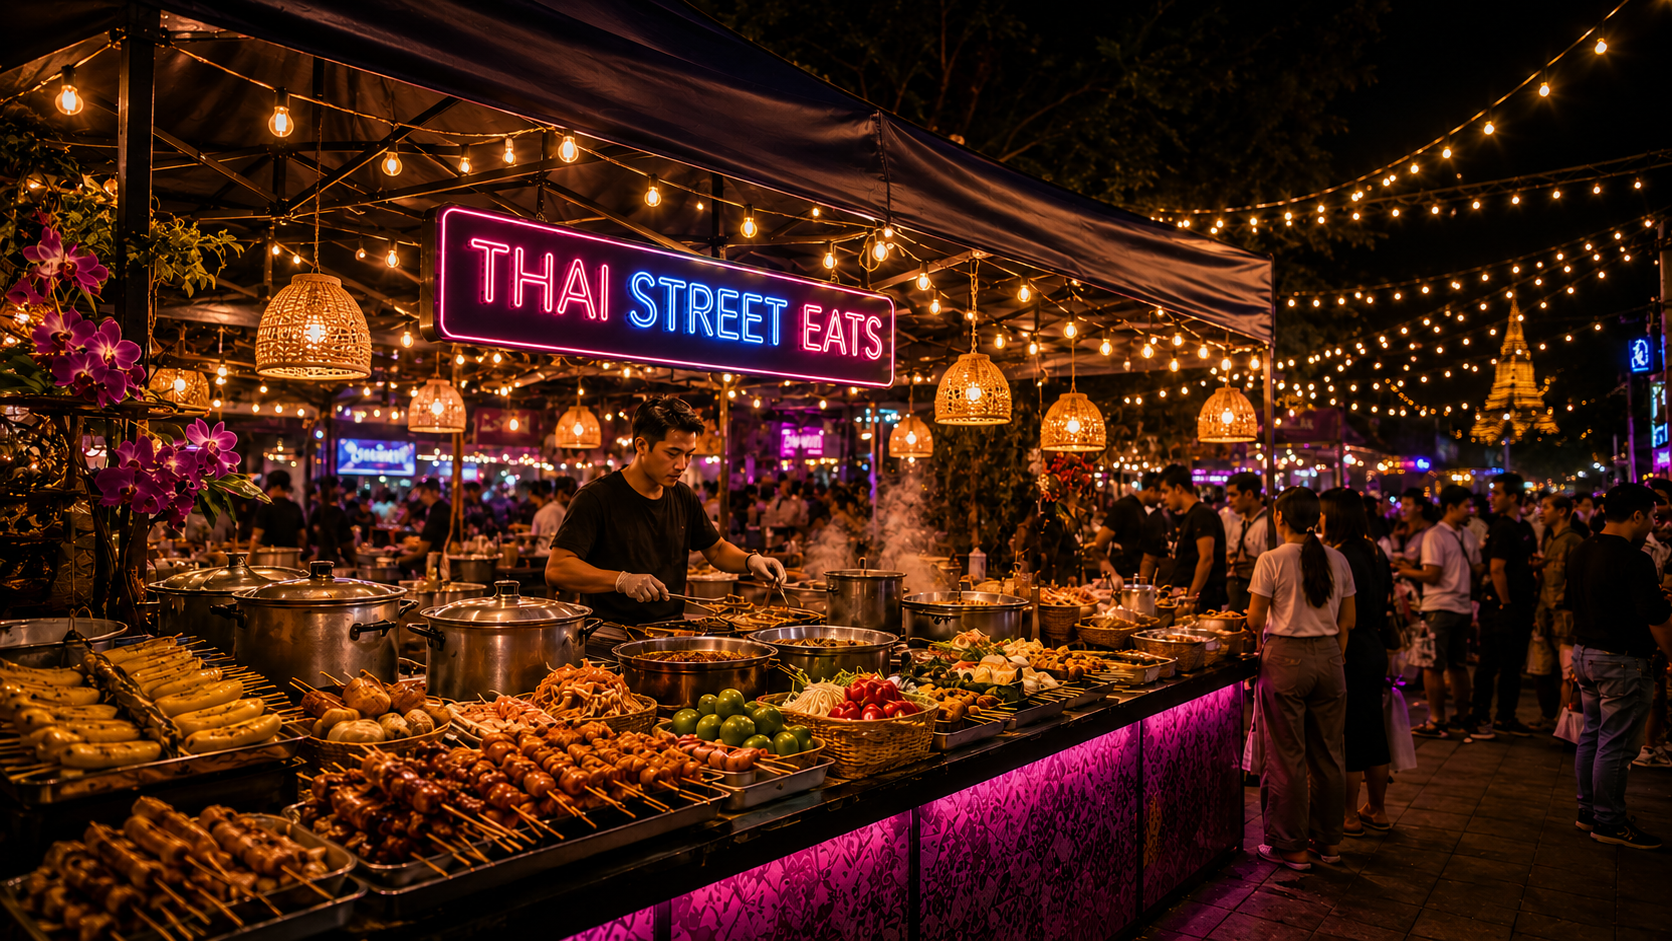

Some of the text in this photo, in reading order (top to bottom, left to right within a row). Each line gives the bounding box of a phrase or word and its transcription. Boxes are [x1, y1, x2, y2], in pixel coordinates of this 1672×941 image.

[470, 238, 883, 360] THAI STREET EATS
